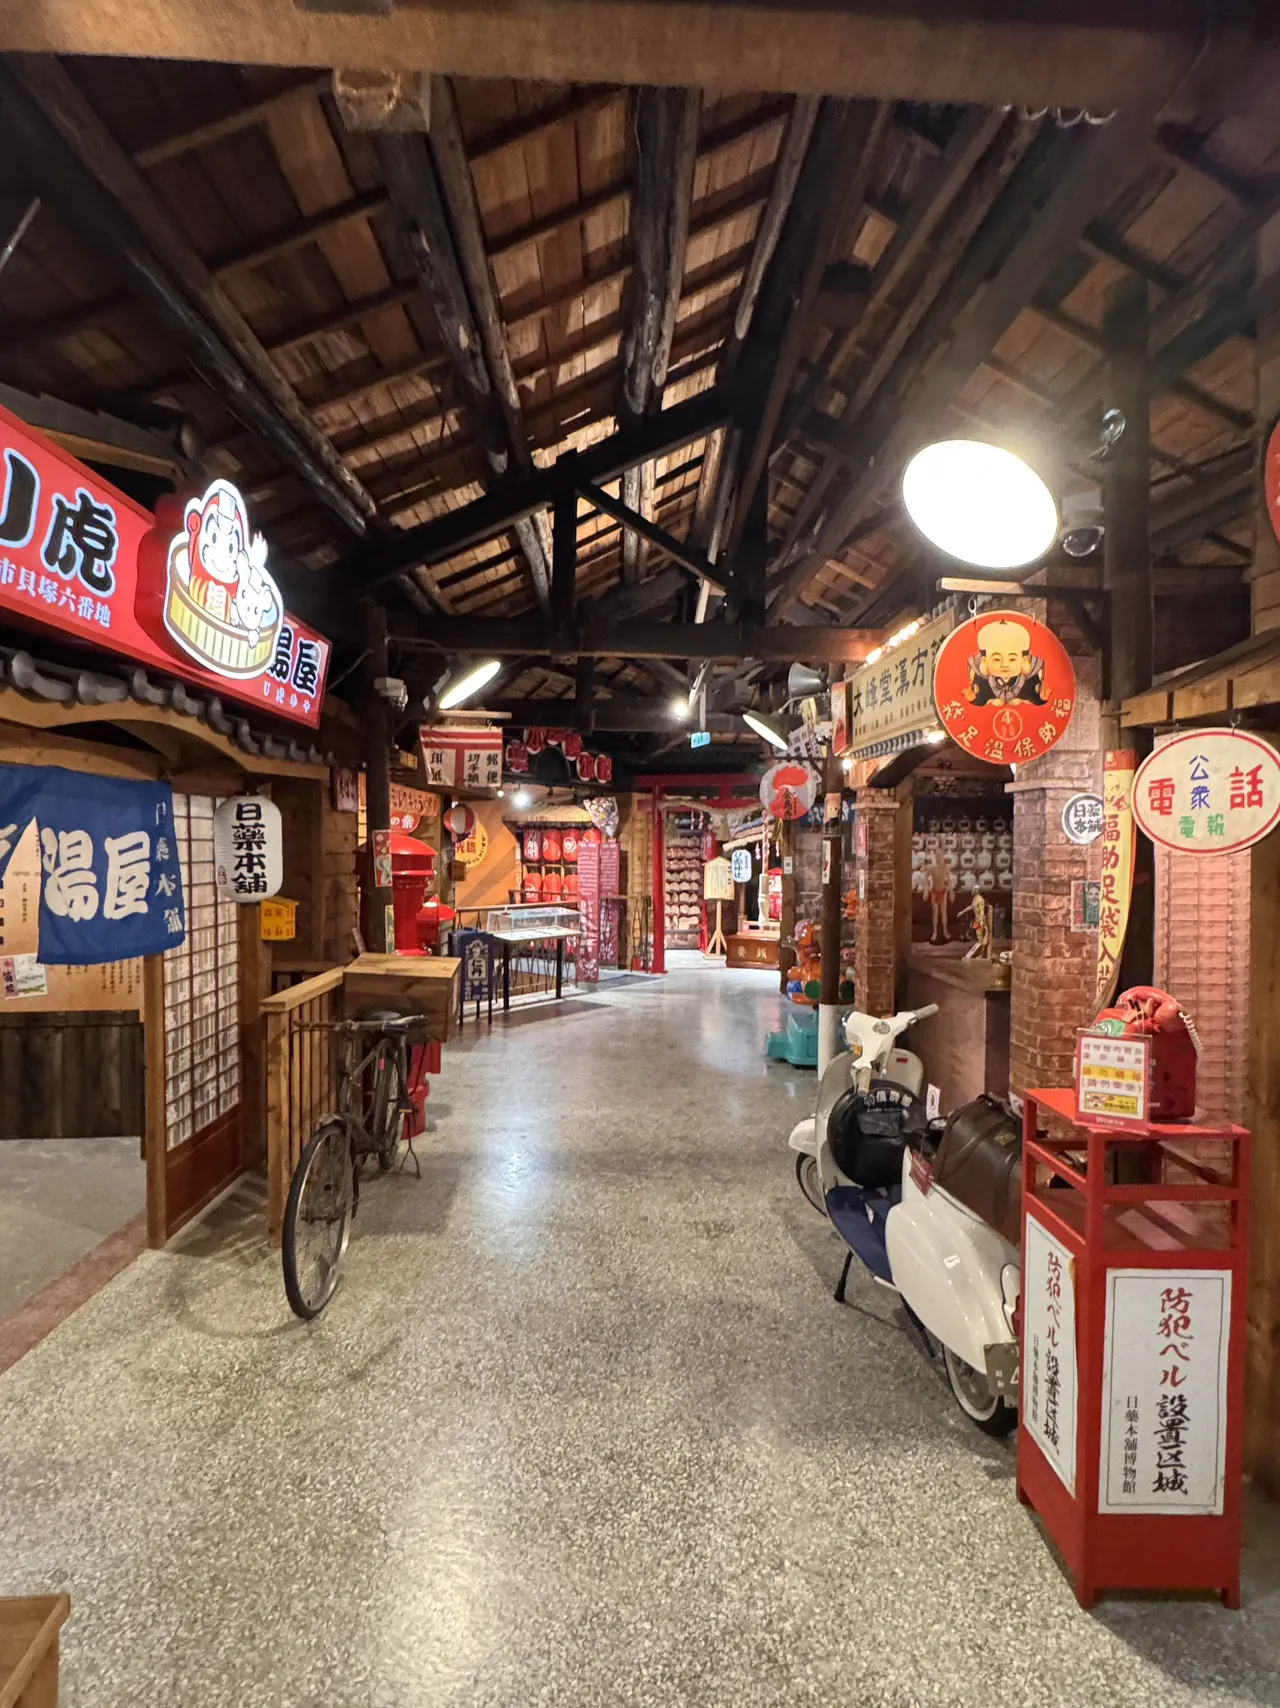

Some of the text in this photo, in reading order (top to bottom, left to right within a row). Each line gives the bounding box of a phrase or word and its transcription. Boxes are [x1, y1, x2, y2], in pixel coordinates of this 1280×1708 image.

[1188, 754, 1211, 811] 公衆
[1179, 813, 1225, 838] 電報
[41, 826, 151, 922] 湯屋
